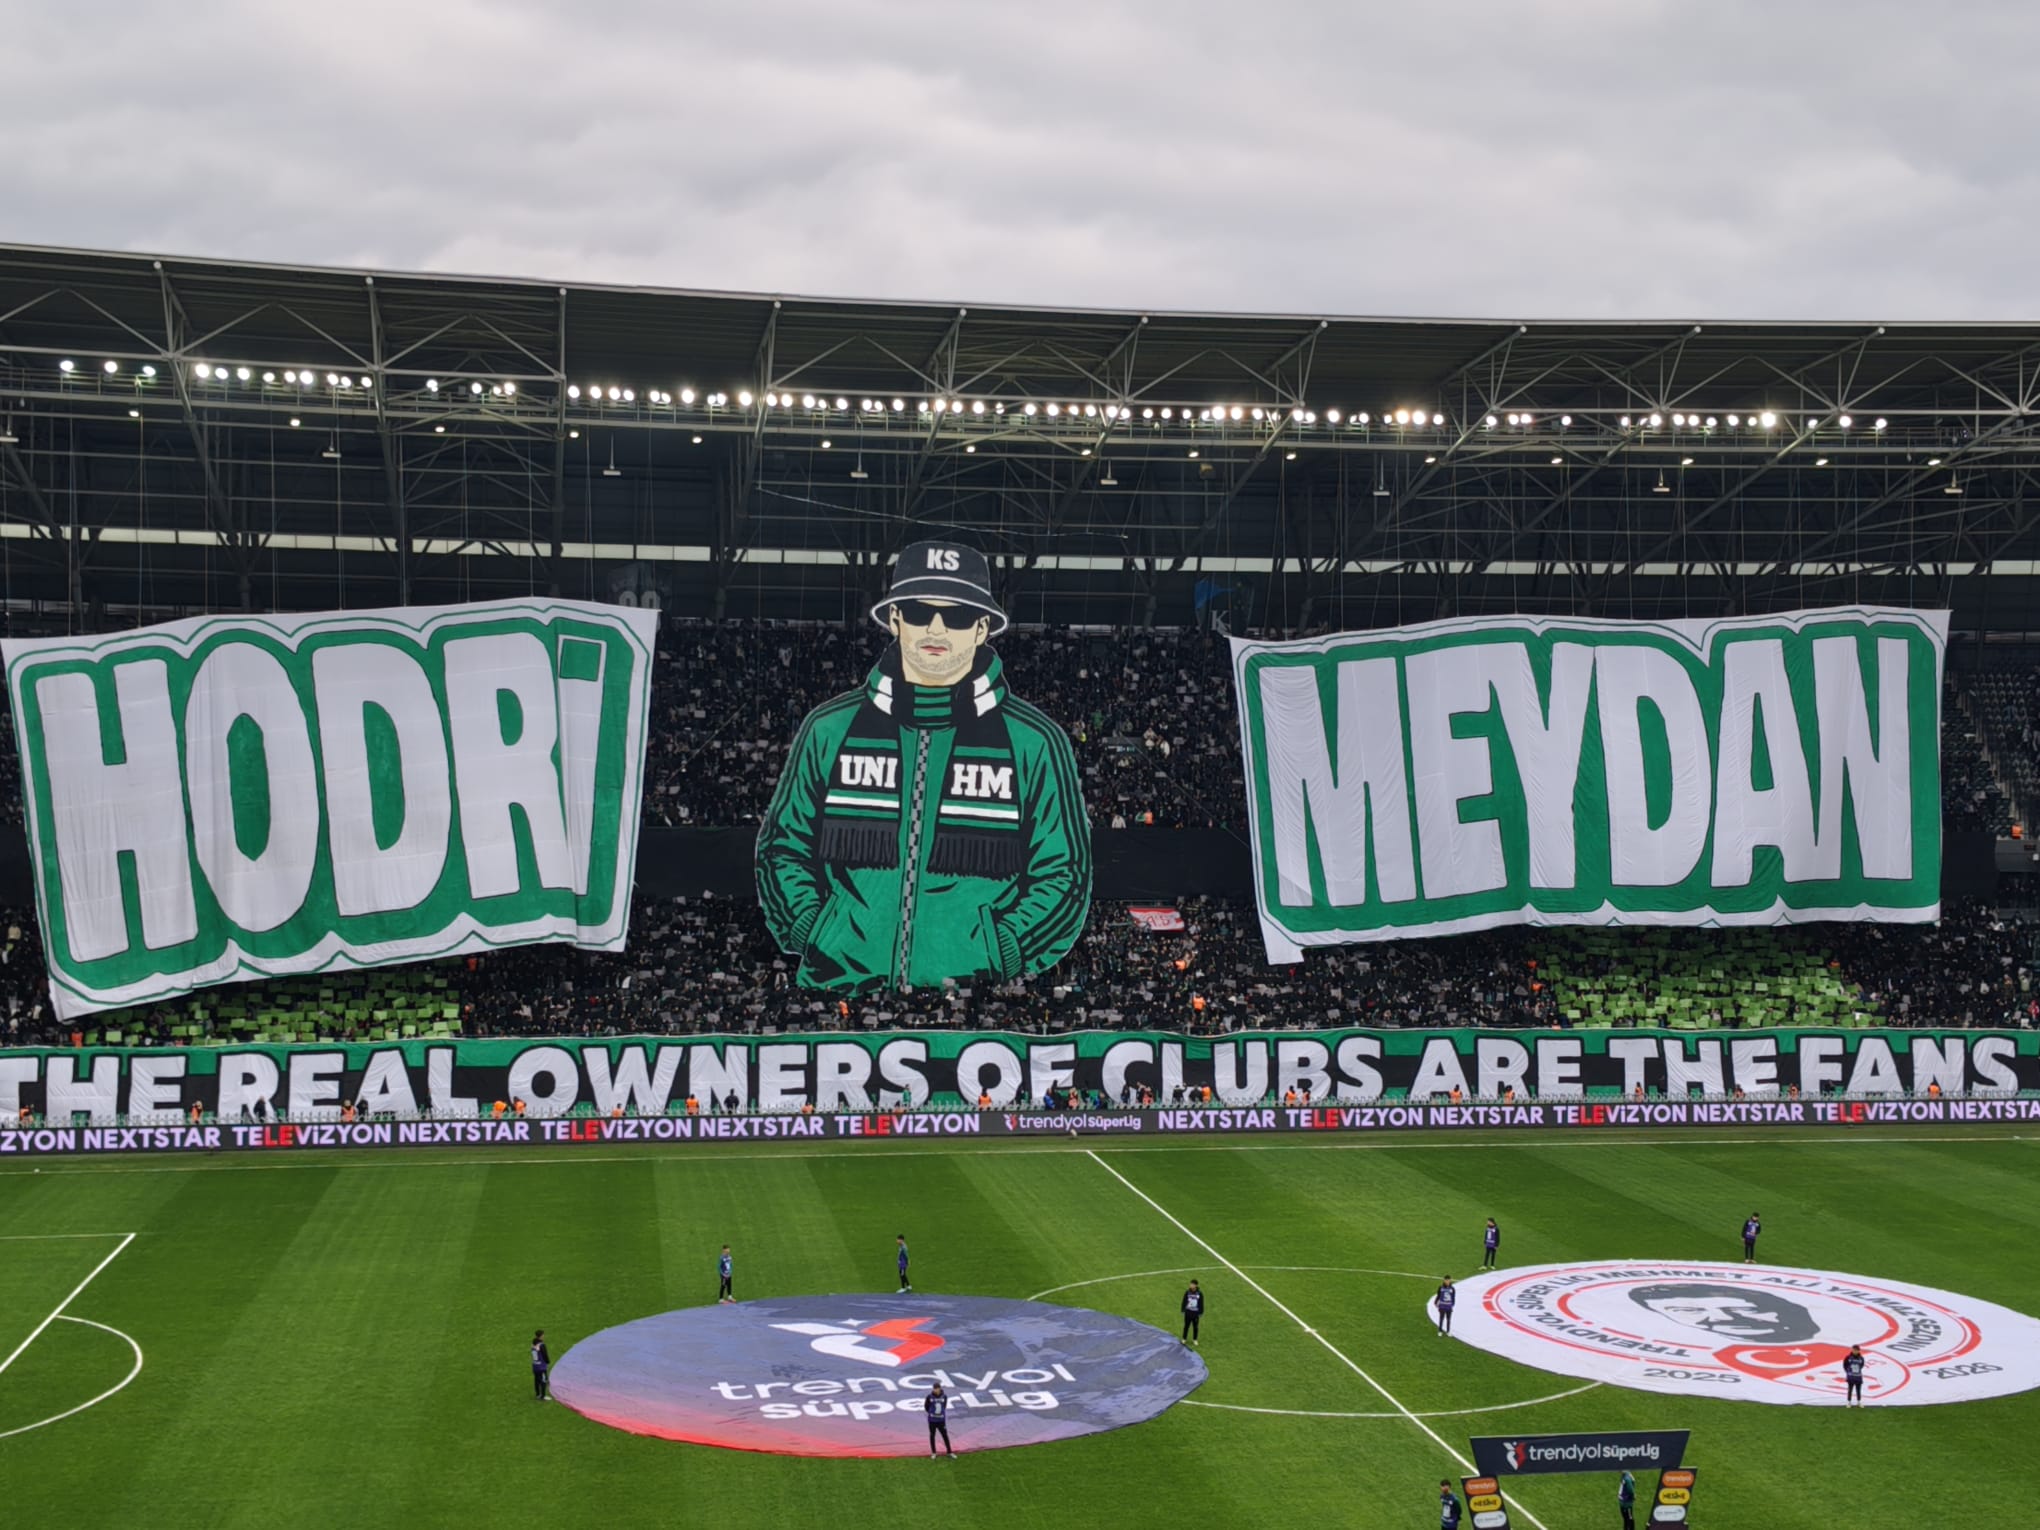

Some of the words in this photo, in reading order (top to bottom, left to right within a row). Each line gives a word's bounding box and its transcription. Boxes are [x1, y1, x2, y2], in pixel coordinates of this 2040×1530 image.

[927, 548, 960, 571] KS
[839, 754, 898, 788] UNI
[951, 763, 1013, 799] HM
[1258, 636, 1913, 908] MEYDAN
[218, 1047, 480, 1121] REAL
[508, 1040, 929, 1115] OWNERS
[957, 1041, 1076, 1110] OF
[1102, 1037, 1384, 1106] CLUBS
[1407, 1038, 1584, 1104] ARE
[1609, 1038, 1781, 1101] THE
[1800, 1037, 2019, 1100] FANS
[84, 1126, 221, 1149] NEXTSTAR
[400, 1120, 529, 1143] NEXTSTAR
[700, 1115, 825, 1137] NEXTSTAR
[1020, 1114, 1087, 1130] trendyol
[1159, 1109, 1276, 1130] NEXTSTAR
[1431, 1106, 1544, 1126] NEXTSTAR
[1694, 1102, 1804, 1122] NEXTSTAR
[1950, 1100, 2040, 1119] NEXTSTA
[1597, 1269, 1749, 1280] MEHMET
[1527, 1311, 1691, 1358] TRENDYOL
[710, 1363, 1077, 1401] trendyol
[1643, 1367, 1742, 1384] 2025
[1921, 1362, 2004, 1380] 2026
[1529, 1443, 1601, 1462] trendyol
